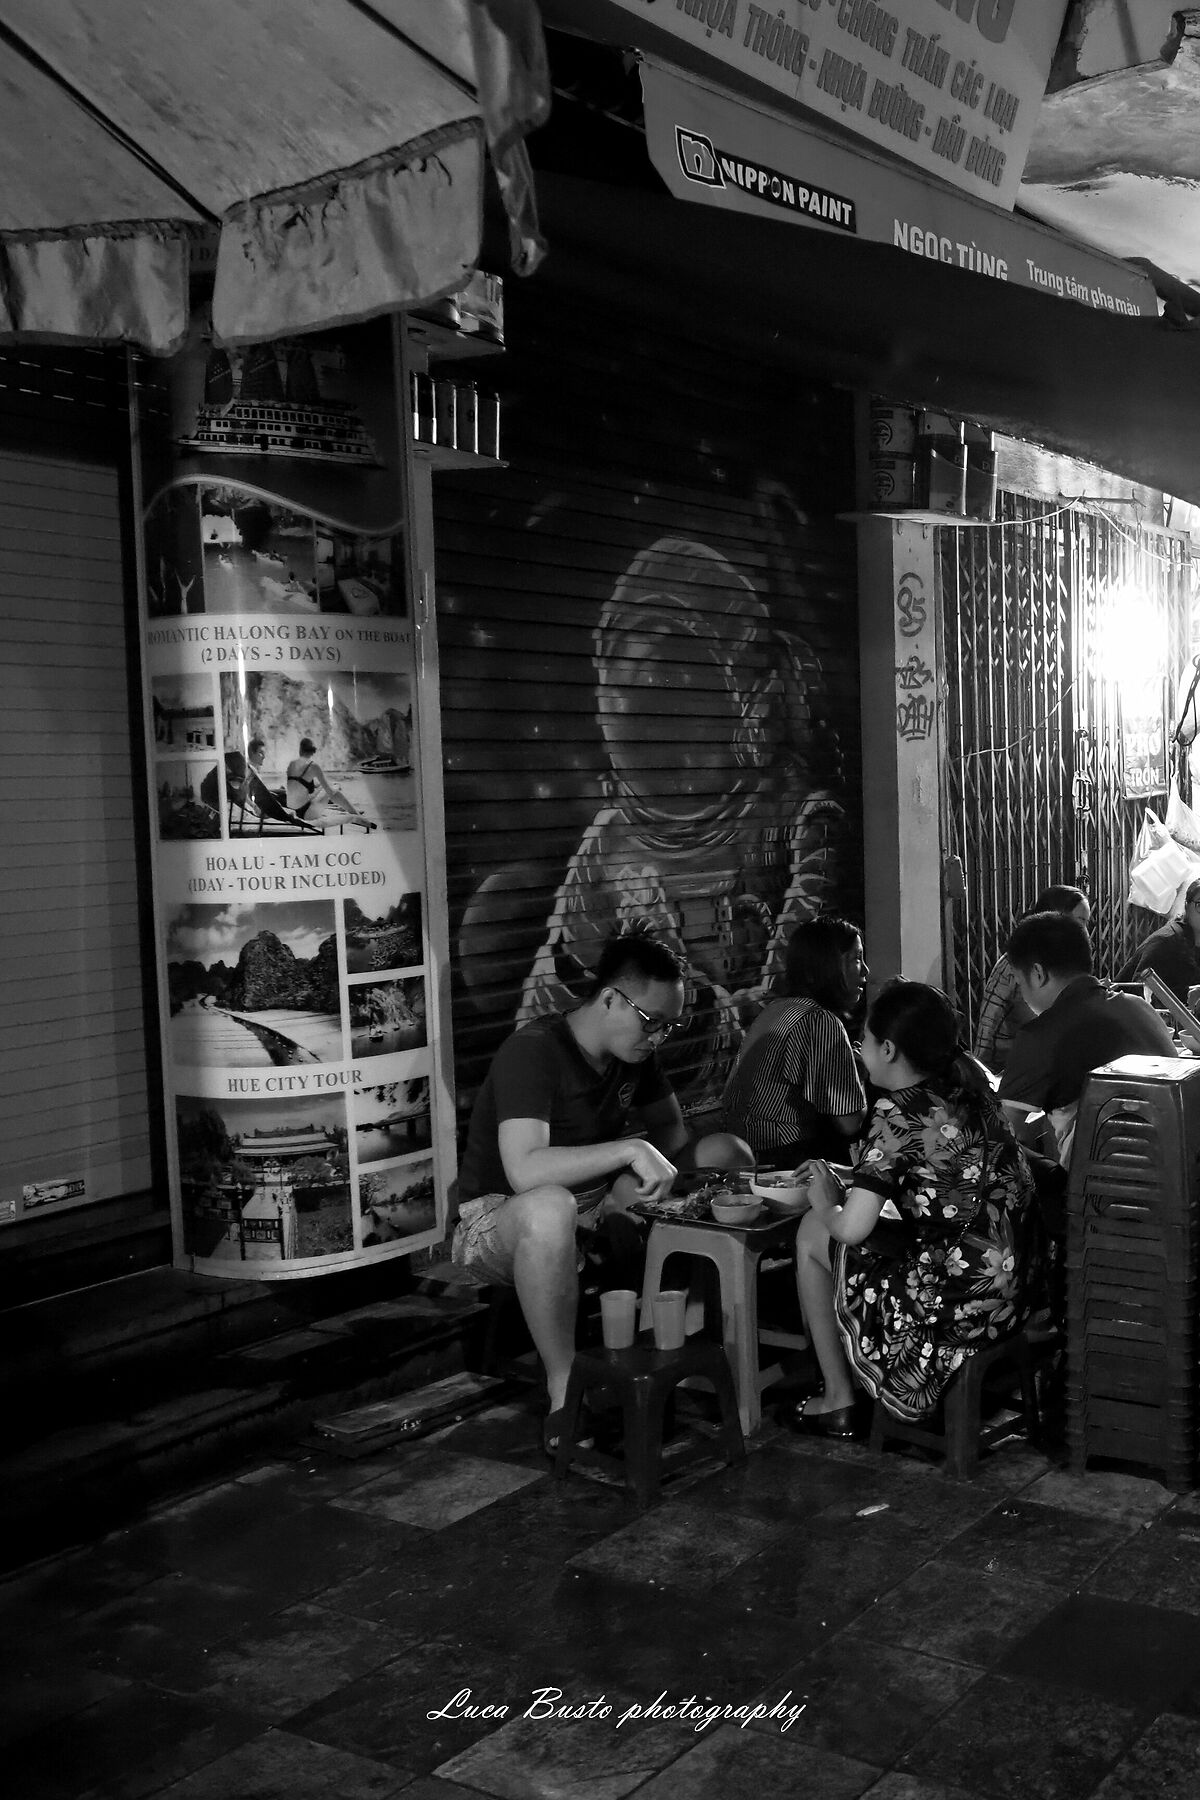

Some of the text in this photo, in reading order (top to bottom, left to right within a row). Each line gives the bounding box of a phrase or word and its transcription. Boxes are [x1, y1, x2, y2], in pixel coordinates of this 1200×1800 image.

[951, 59, 985, 110] CÁC
[721, 157, 795, 206] NIPPON
[799, 186, 852, 226] PAINT
[1026, 259, 1064, 296] Trung
[1065, 276, 1089, 302] tâm
[214, 625, 290, 641] HALONG
[296, 625, 330, 640] BAY
[335, 629, 353, 640] ON
[357, 630, 382, 643] THE
[383, 631, 411, 643] BOAT
[217, 646, 260, 661] DAYS
[275, 647, 284, 661] 3
[290, 646, 341, 663] DAYS)
[206, 856, 238, 871] HOA
[242, 855, 265, 870] LU
[280, 854, 319, 869] TAM
[325, 851, 362, 867] COC
[237, 875, 287, 891] TOUR
[292, 870, 386, 890] INCLUDED)
[228, 1069, 363, 1092] HUE CITY TOUR
